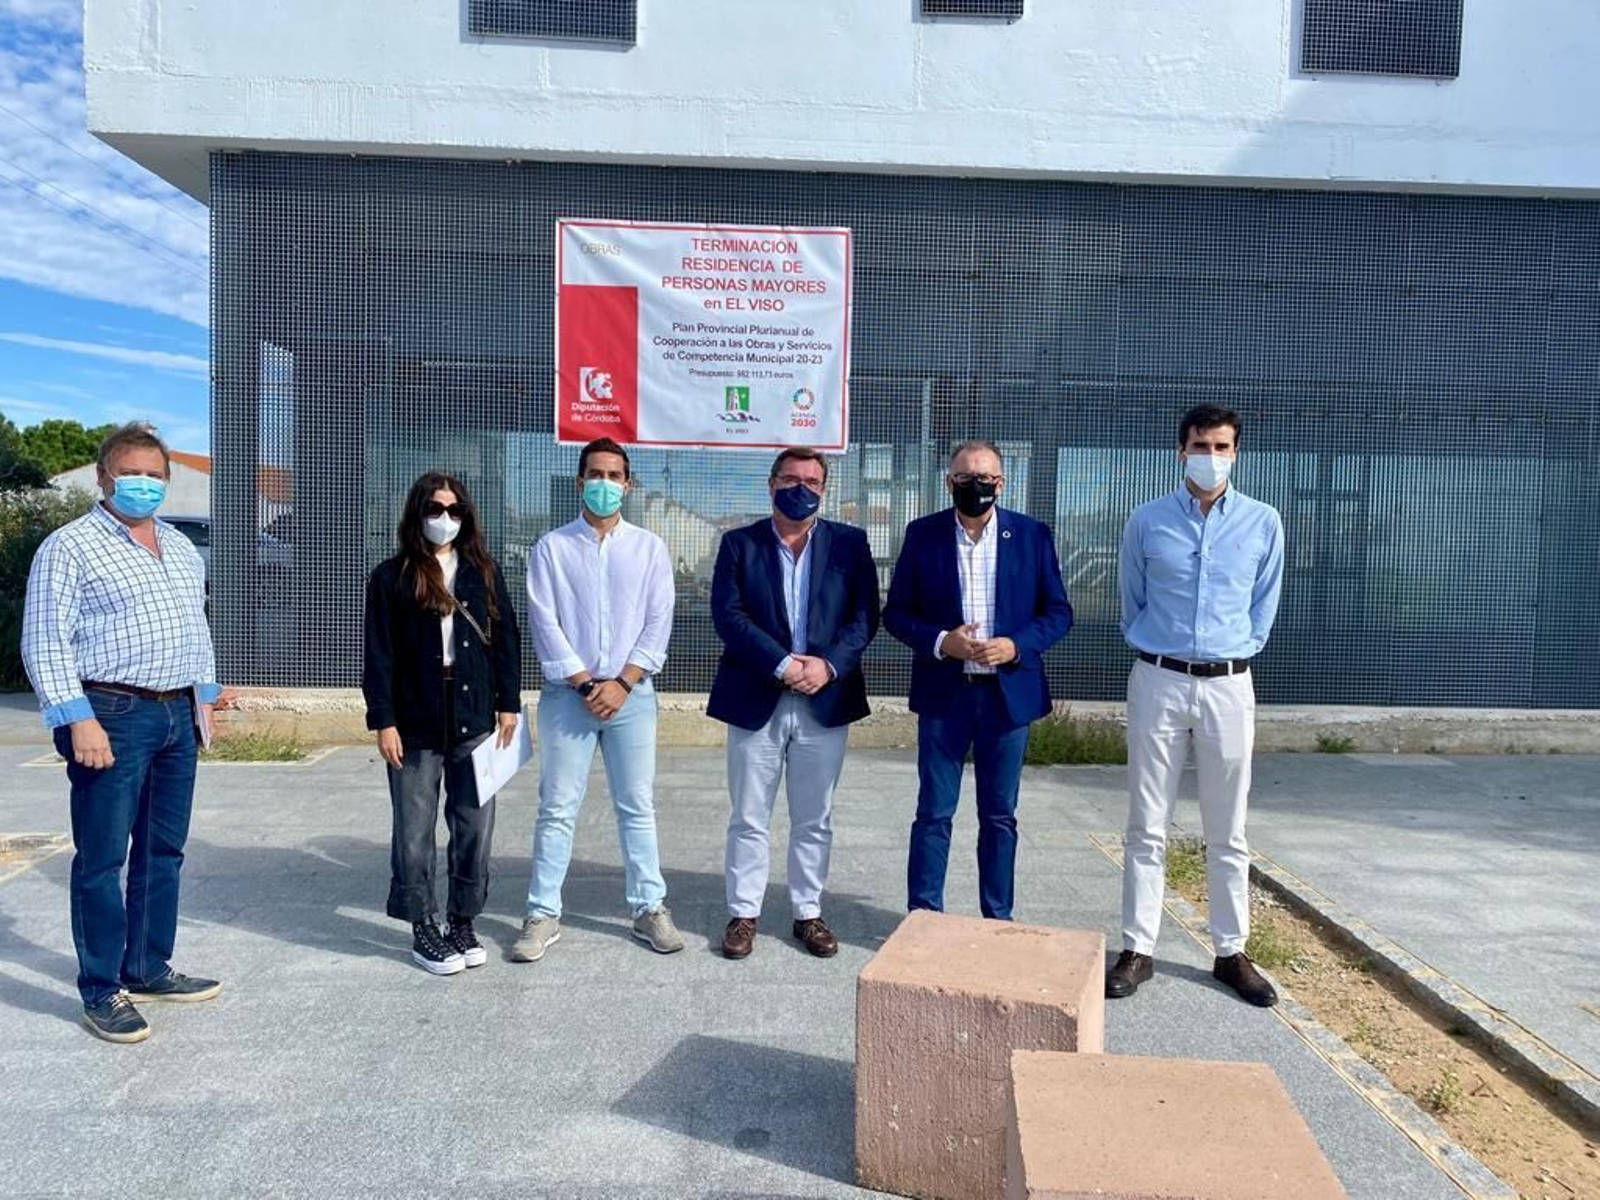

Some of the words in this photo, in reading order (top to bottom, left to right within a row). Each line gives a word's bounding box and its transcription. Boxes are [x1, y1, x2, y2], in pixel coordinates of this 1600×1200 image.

[580, 243, 620, 256] OBRAS
[681, 257, 775, 272] RESIDENCIA
[782, 261, 803, 273] DE
[661, 277, 747, 291] PERSONAS
[751, 279, 826, 293] MAYORES
[704, 301, 722, 309] en
[726, 298, 745, 310] EL
[748, 299, 785, 312] VISO
[672, 323, 695, 333] Plan
[697, 323, 748, 335] Provincial
[750, 325, 799, 336] Plurianual
[802, 327, 815, 337] de
[653, 336, 717, 348] Cooperación
[729, 338, 743, 348] las
[745, 339, 776, 349] Obras
[778, 342, 784, 351] y
[787, 340, 832, 351] Servicios
[662, 351, 676, 360] de
[677, 352, 744, 363] Competencia
[746, 353, 794, 365] Municipal
[796, 354, 823, 364] 20-23
[571, 402, 621, 413] Diputación
[571, 413, 582, 422] de
[584, 413, 621, 423] Córdoba
[791, 418, 816, 427] 2030
